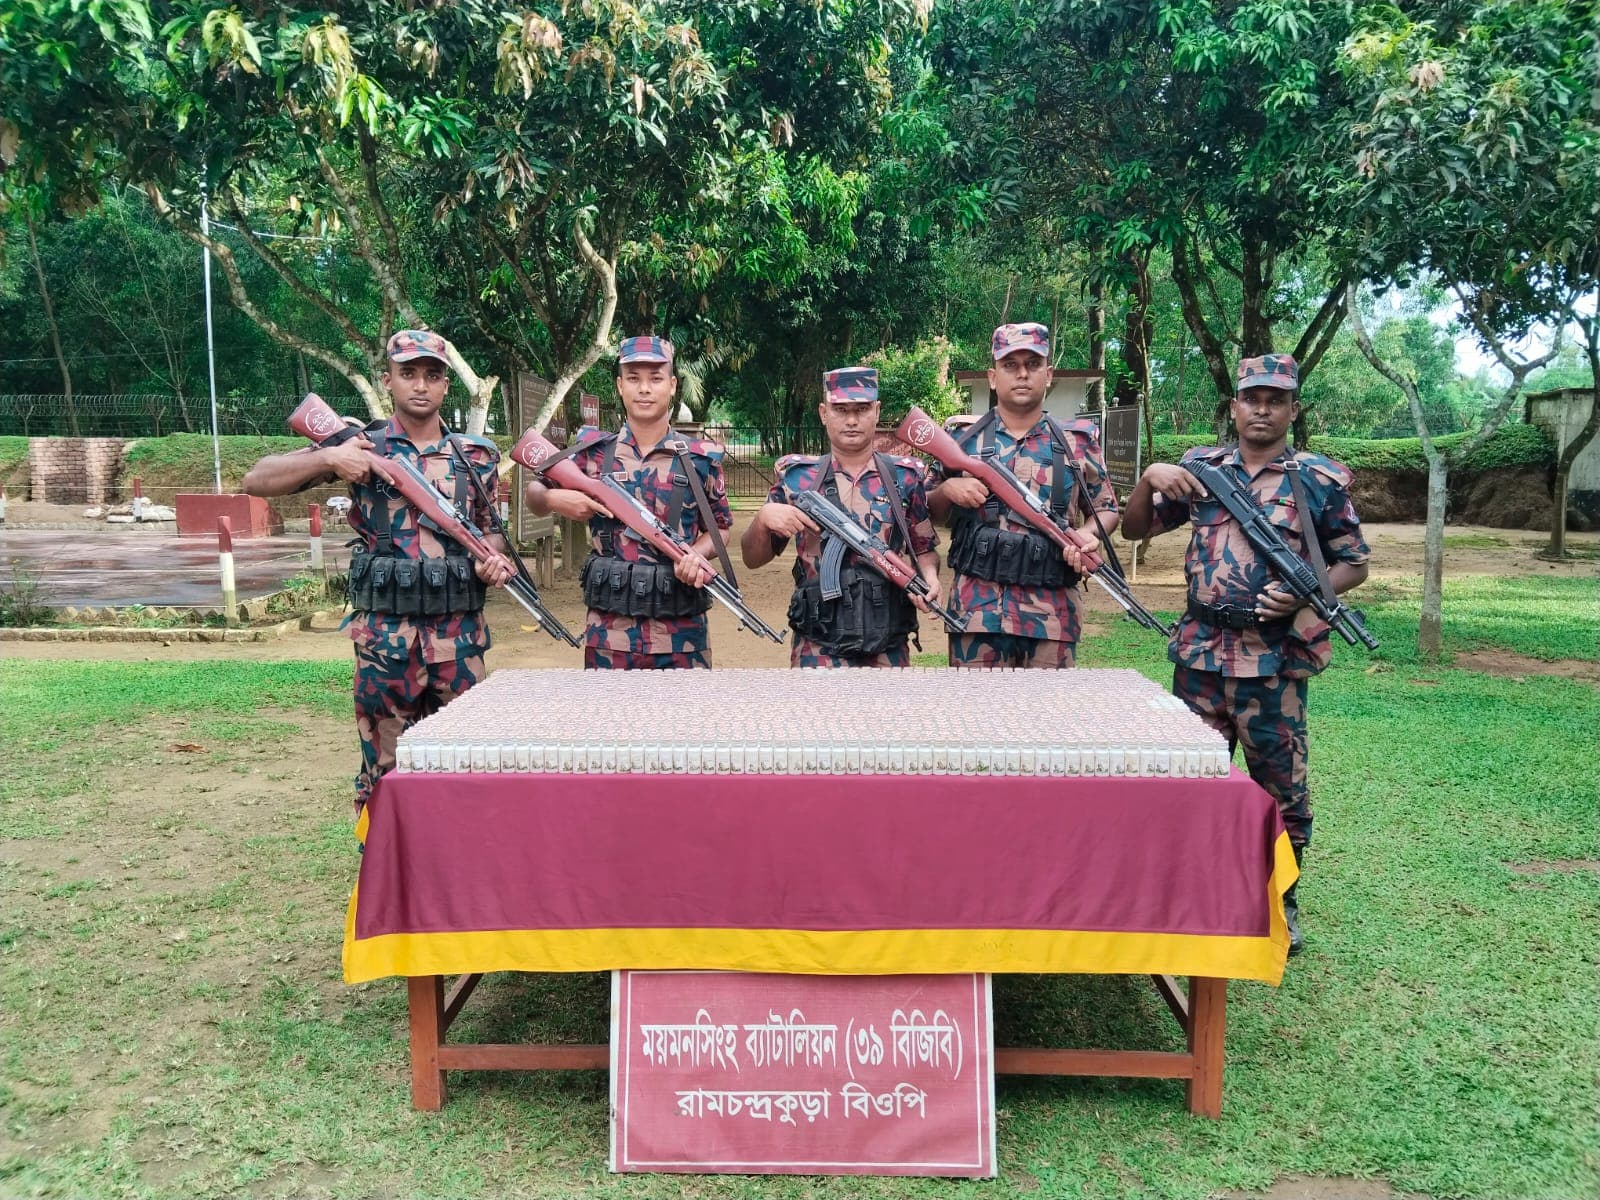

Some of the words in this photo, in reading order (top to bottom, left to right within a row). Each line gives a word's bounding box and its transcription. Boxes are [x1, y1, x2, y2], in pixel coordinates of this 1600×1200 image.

[640, 1009, 738, 1073] ময়মনসিংহ
[743, 1009, 838, 1068] ব্যাটালিয়ন
[845, 1017, 884, 1080] (৩৯
[889, 1009, 963, 1080] বিজিবি)
[675, 1087, 832, 1126] রামচন্দ্রকুড়া
[840, 1082, 927, 1120] বিওপি
